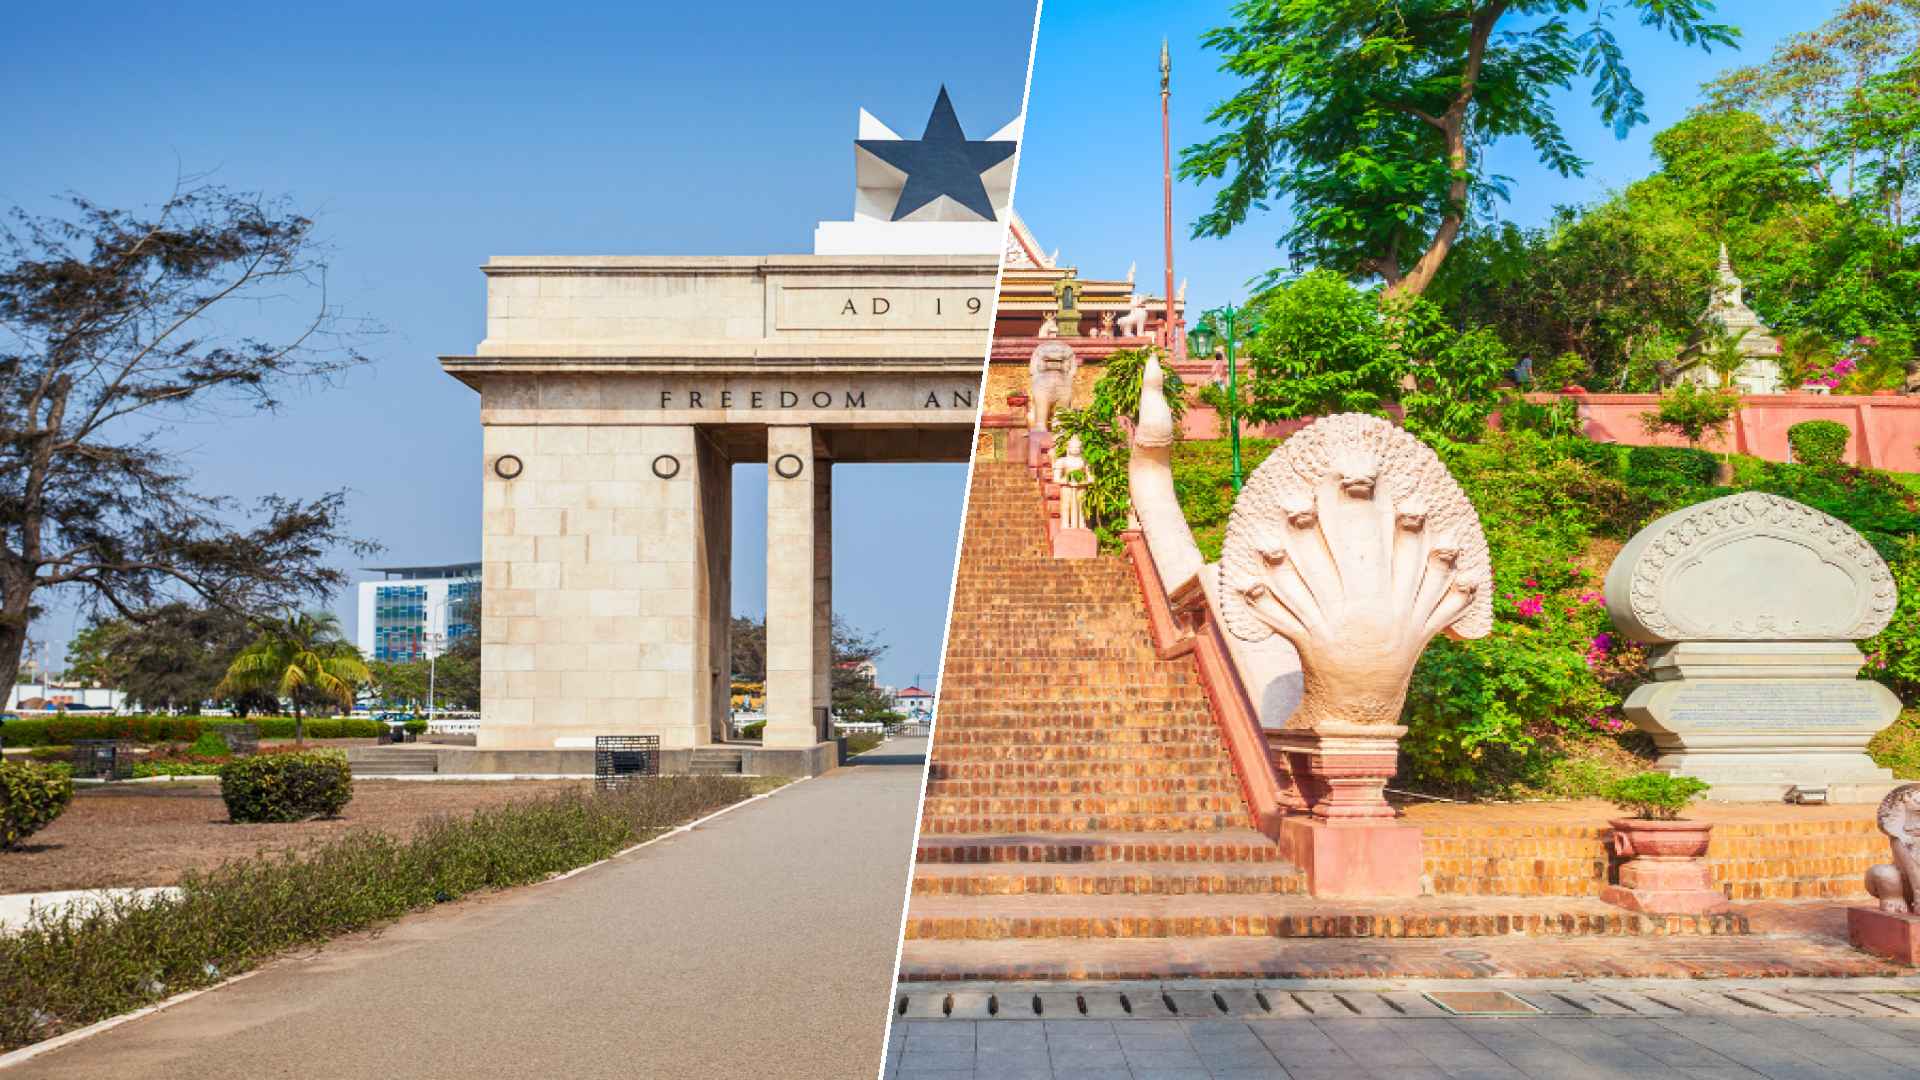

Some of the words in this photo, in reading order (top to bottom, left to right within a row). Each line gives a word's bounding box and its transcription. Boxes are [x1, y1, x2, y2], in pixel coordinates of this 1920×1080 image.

[841, 298, 891, 316] AD
[660, 391, 866, 409] FREEDOM
[923, 391, 973, 409] AN
